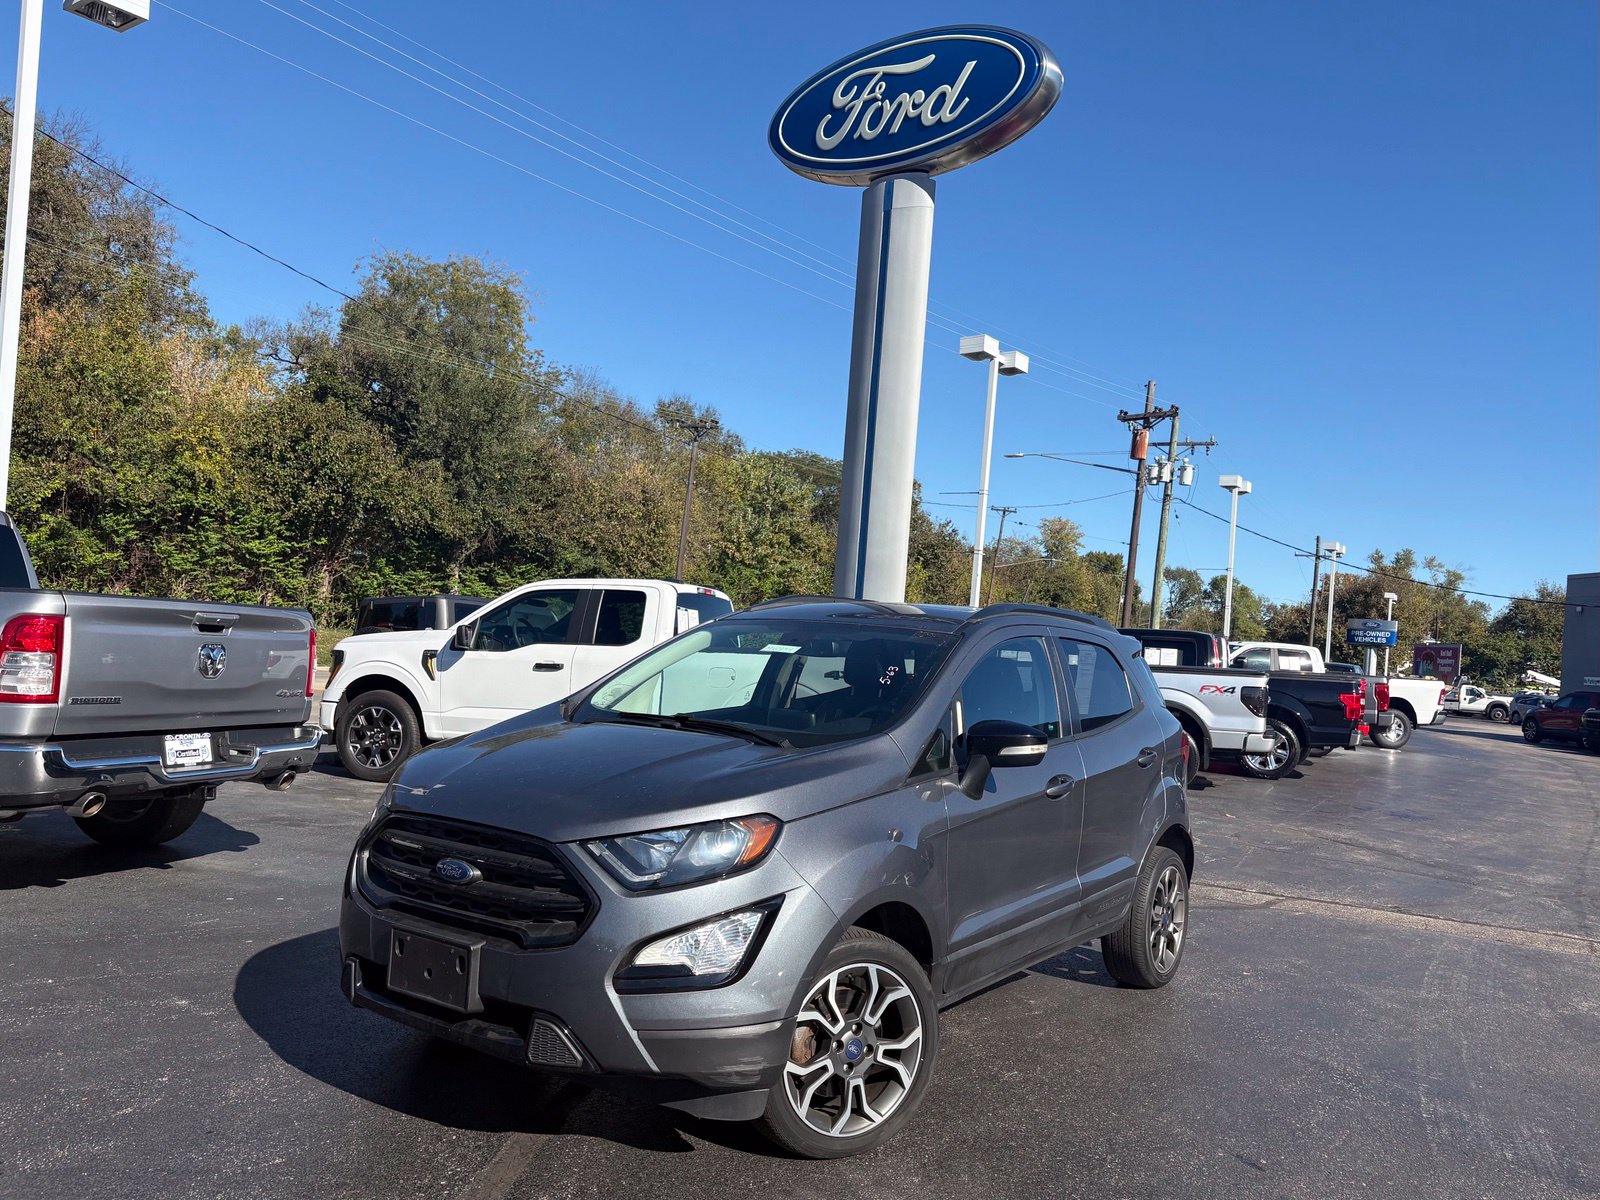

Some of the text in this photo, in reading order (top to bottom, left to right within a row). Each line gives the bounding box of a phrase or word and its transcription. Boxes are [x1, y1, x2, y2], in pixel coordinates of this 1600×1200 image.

[815, 54, 977, 150] Ford
[1351, 630, 1391, 638] PRE-OWNED
[1199, 685, 1237, 694] FX4
[441, 864, 462, 878] Ford
